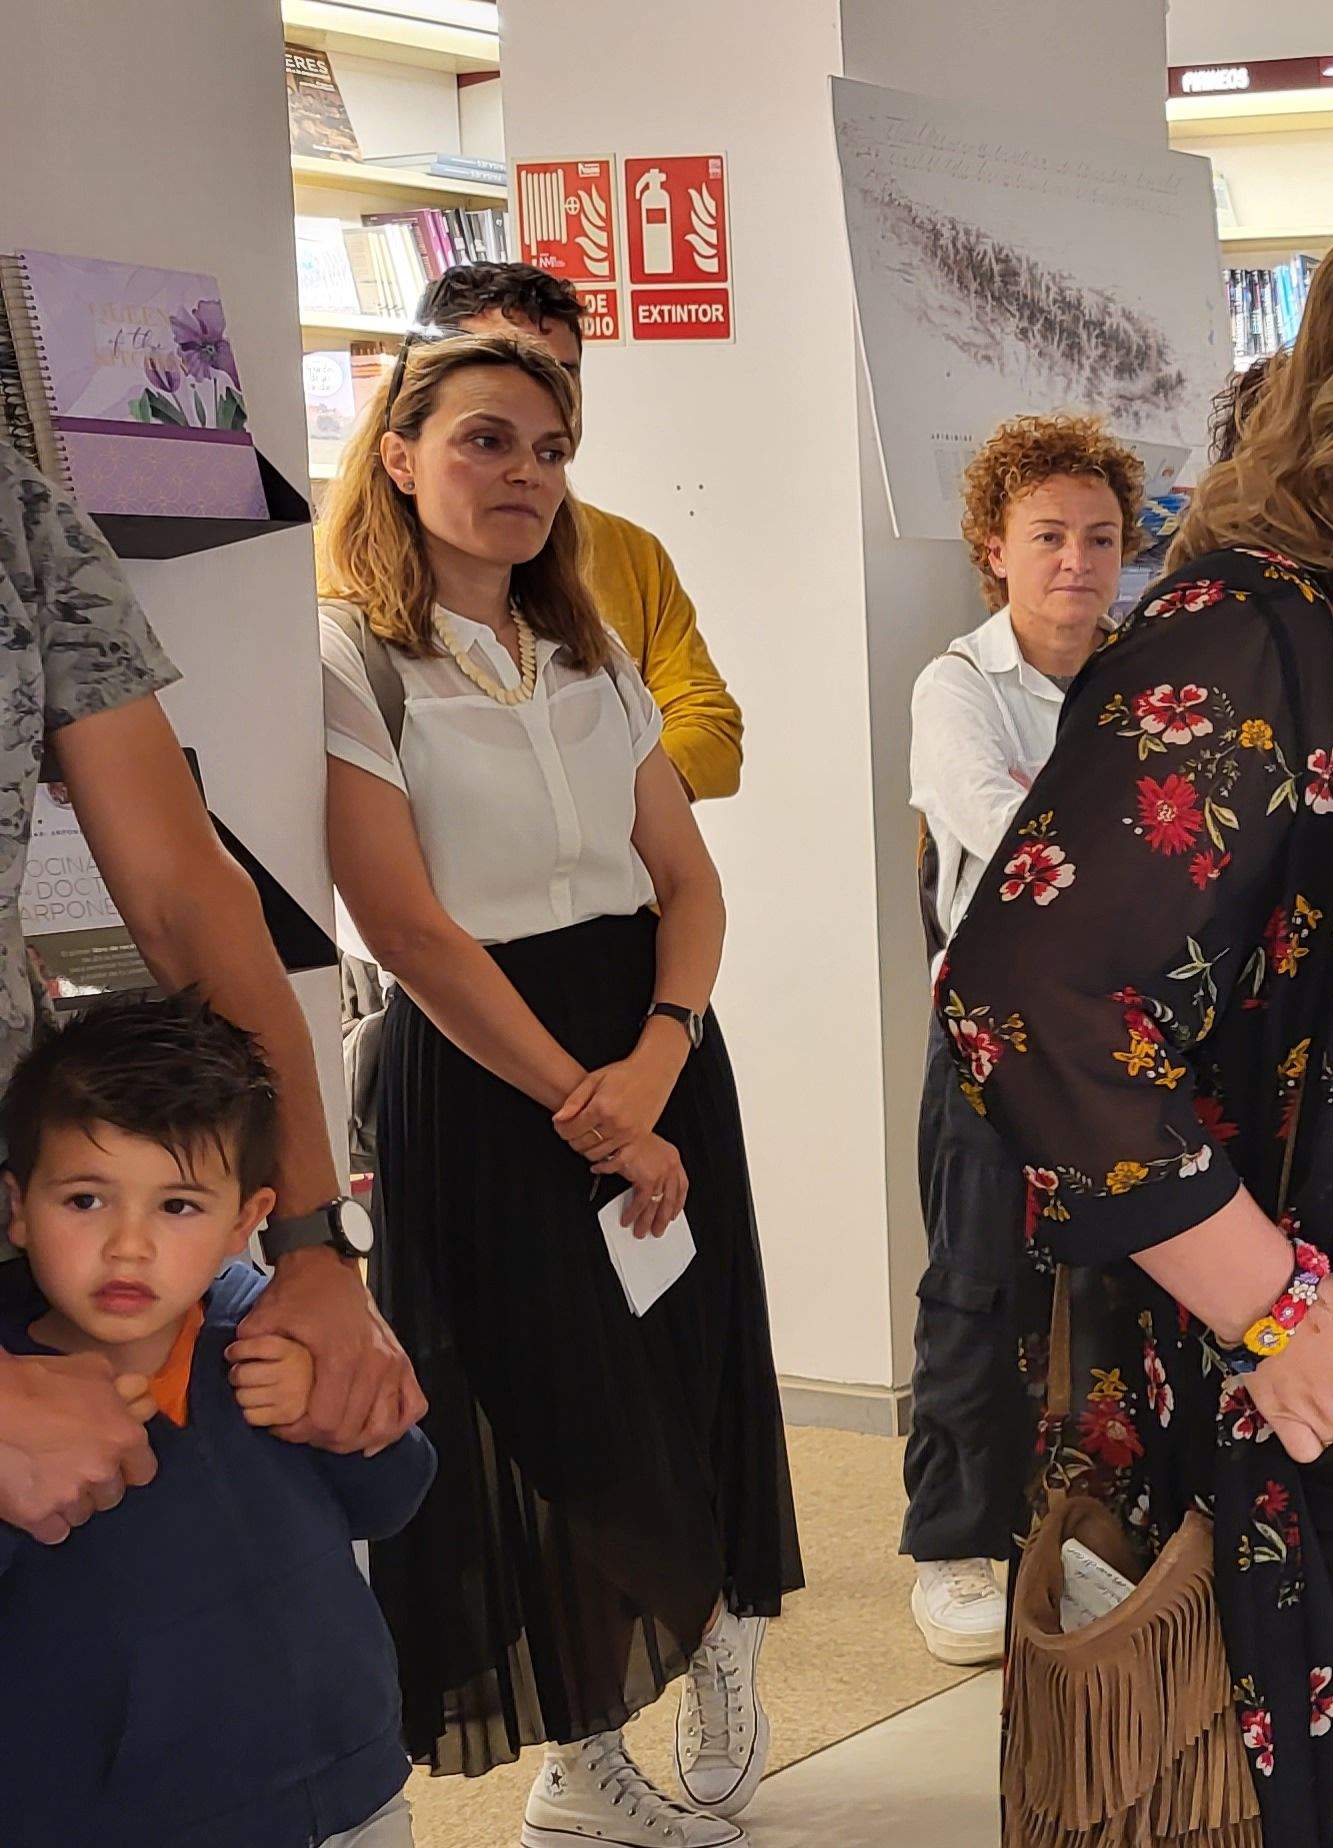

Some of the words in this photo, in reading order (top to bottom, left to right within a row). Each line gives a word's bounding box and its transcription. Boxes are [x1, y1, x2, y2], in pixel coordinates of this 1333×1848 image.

[284, 53, 329, 76] ERES
[585, 294, 608, 314] DE
[638, 303, 724, 324] EXTINTOR
[583, 316, 614, 337] DIO
[26, 857, 100, 878] OCINA
[37, 877, 105, 899] DOCT
[20, 898, 119, 921] ARPONE
